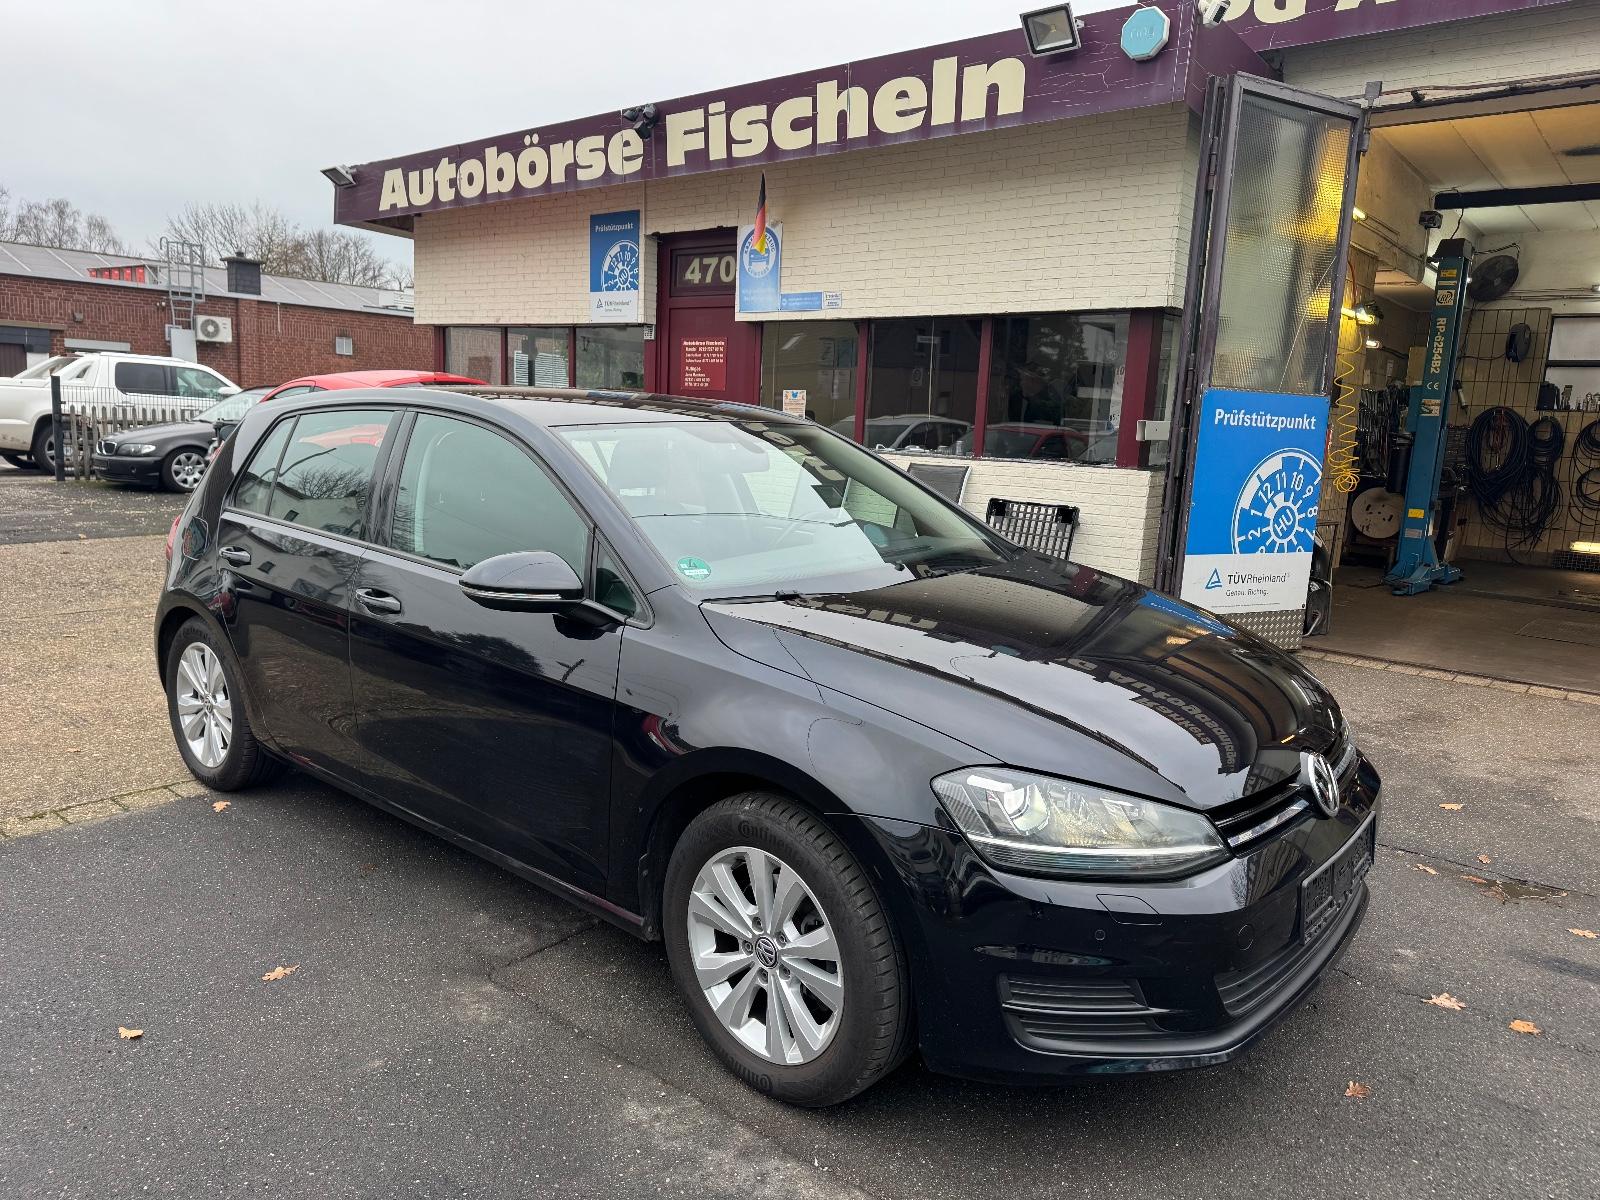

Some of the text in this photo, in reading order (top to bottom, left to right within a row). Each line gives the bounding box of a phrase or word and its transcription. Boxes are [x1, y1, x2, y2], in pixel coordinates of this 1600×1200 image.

[378, 56, 1026, 212] Autobörse Fischeln
[595, 222, 634, 233] Prüfstützpunkt
[685, 255, 736, 284] 470
[1430, 317, 1447, 374] RP-6254B2
[1214, 408, 1317, 432] Prüfstützpunkt
[1258, 482, 1275, 503] 12
[1275, 471, 1287, 491] 11
[1291, 471, 1304, 491] 10
[1302, 485, 1314, 499] 9
[1248, 527, 1261, 541] 2
[1273, 508, 1294, 537] HU
